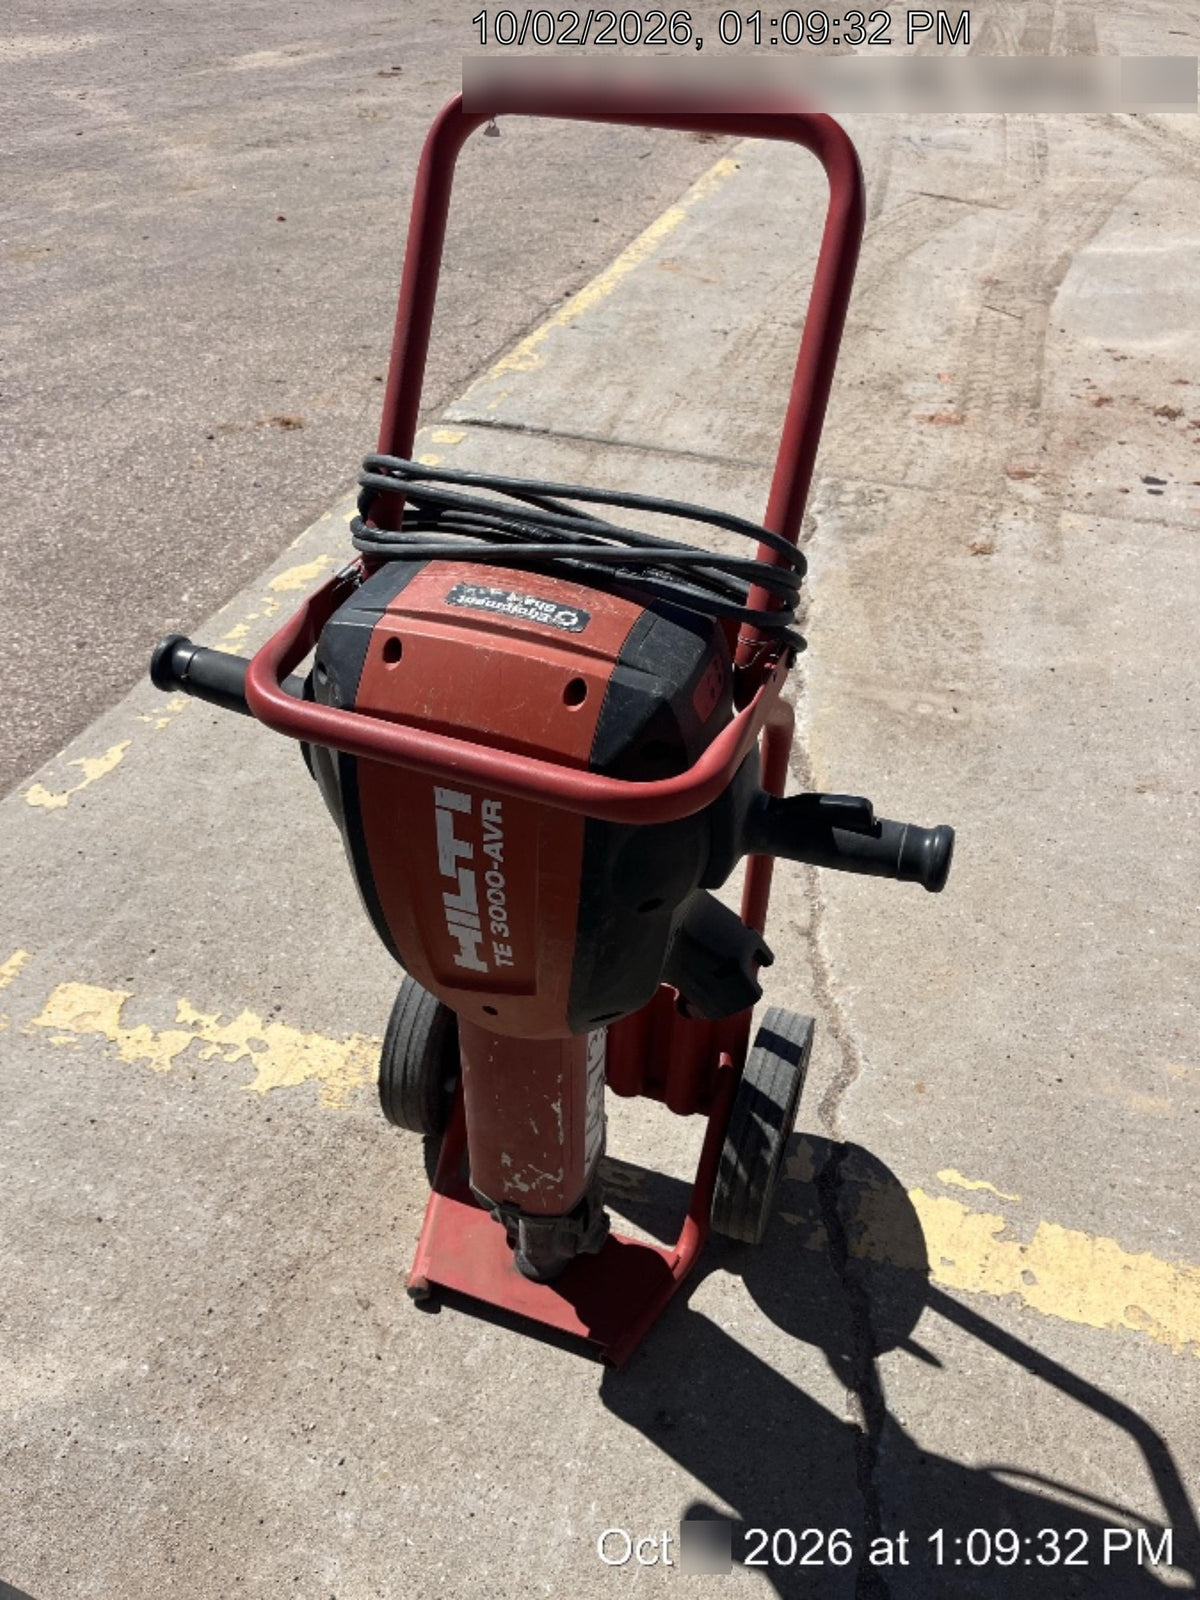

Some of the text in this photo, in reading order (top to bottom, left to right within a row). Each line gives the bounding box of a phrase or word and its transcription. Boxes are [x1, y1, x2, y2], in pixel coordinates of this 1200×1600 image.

[434, 787, 488, 973] HILTI
[482, 798, 514, 968] TE 3000-AVR
